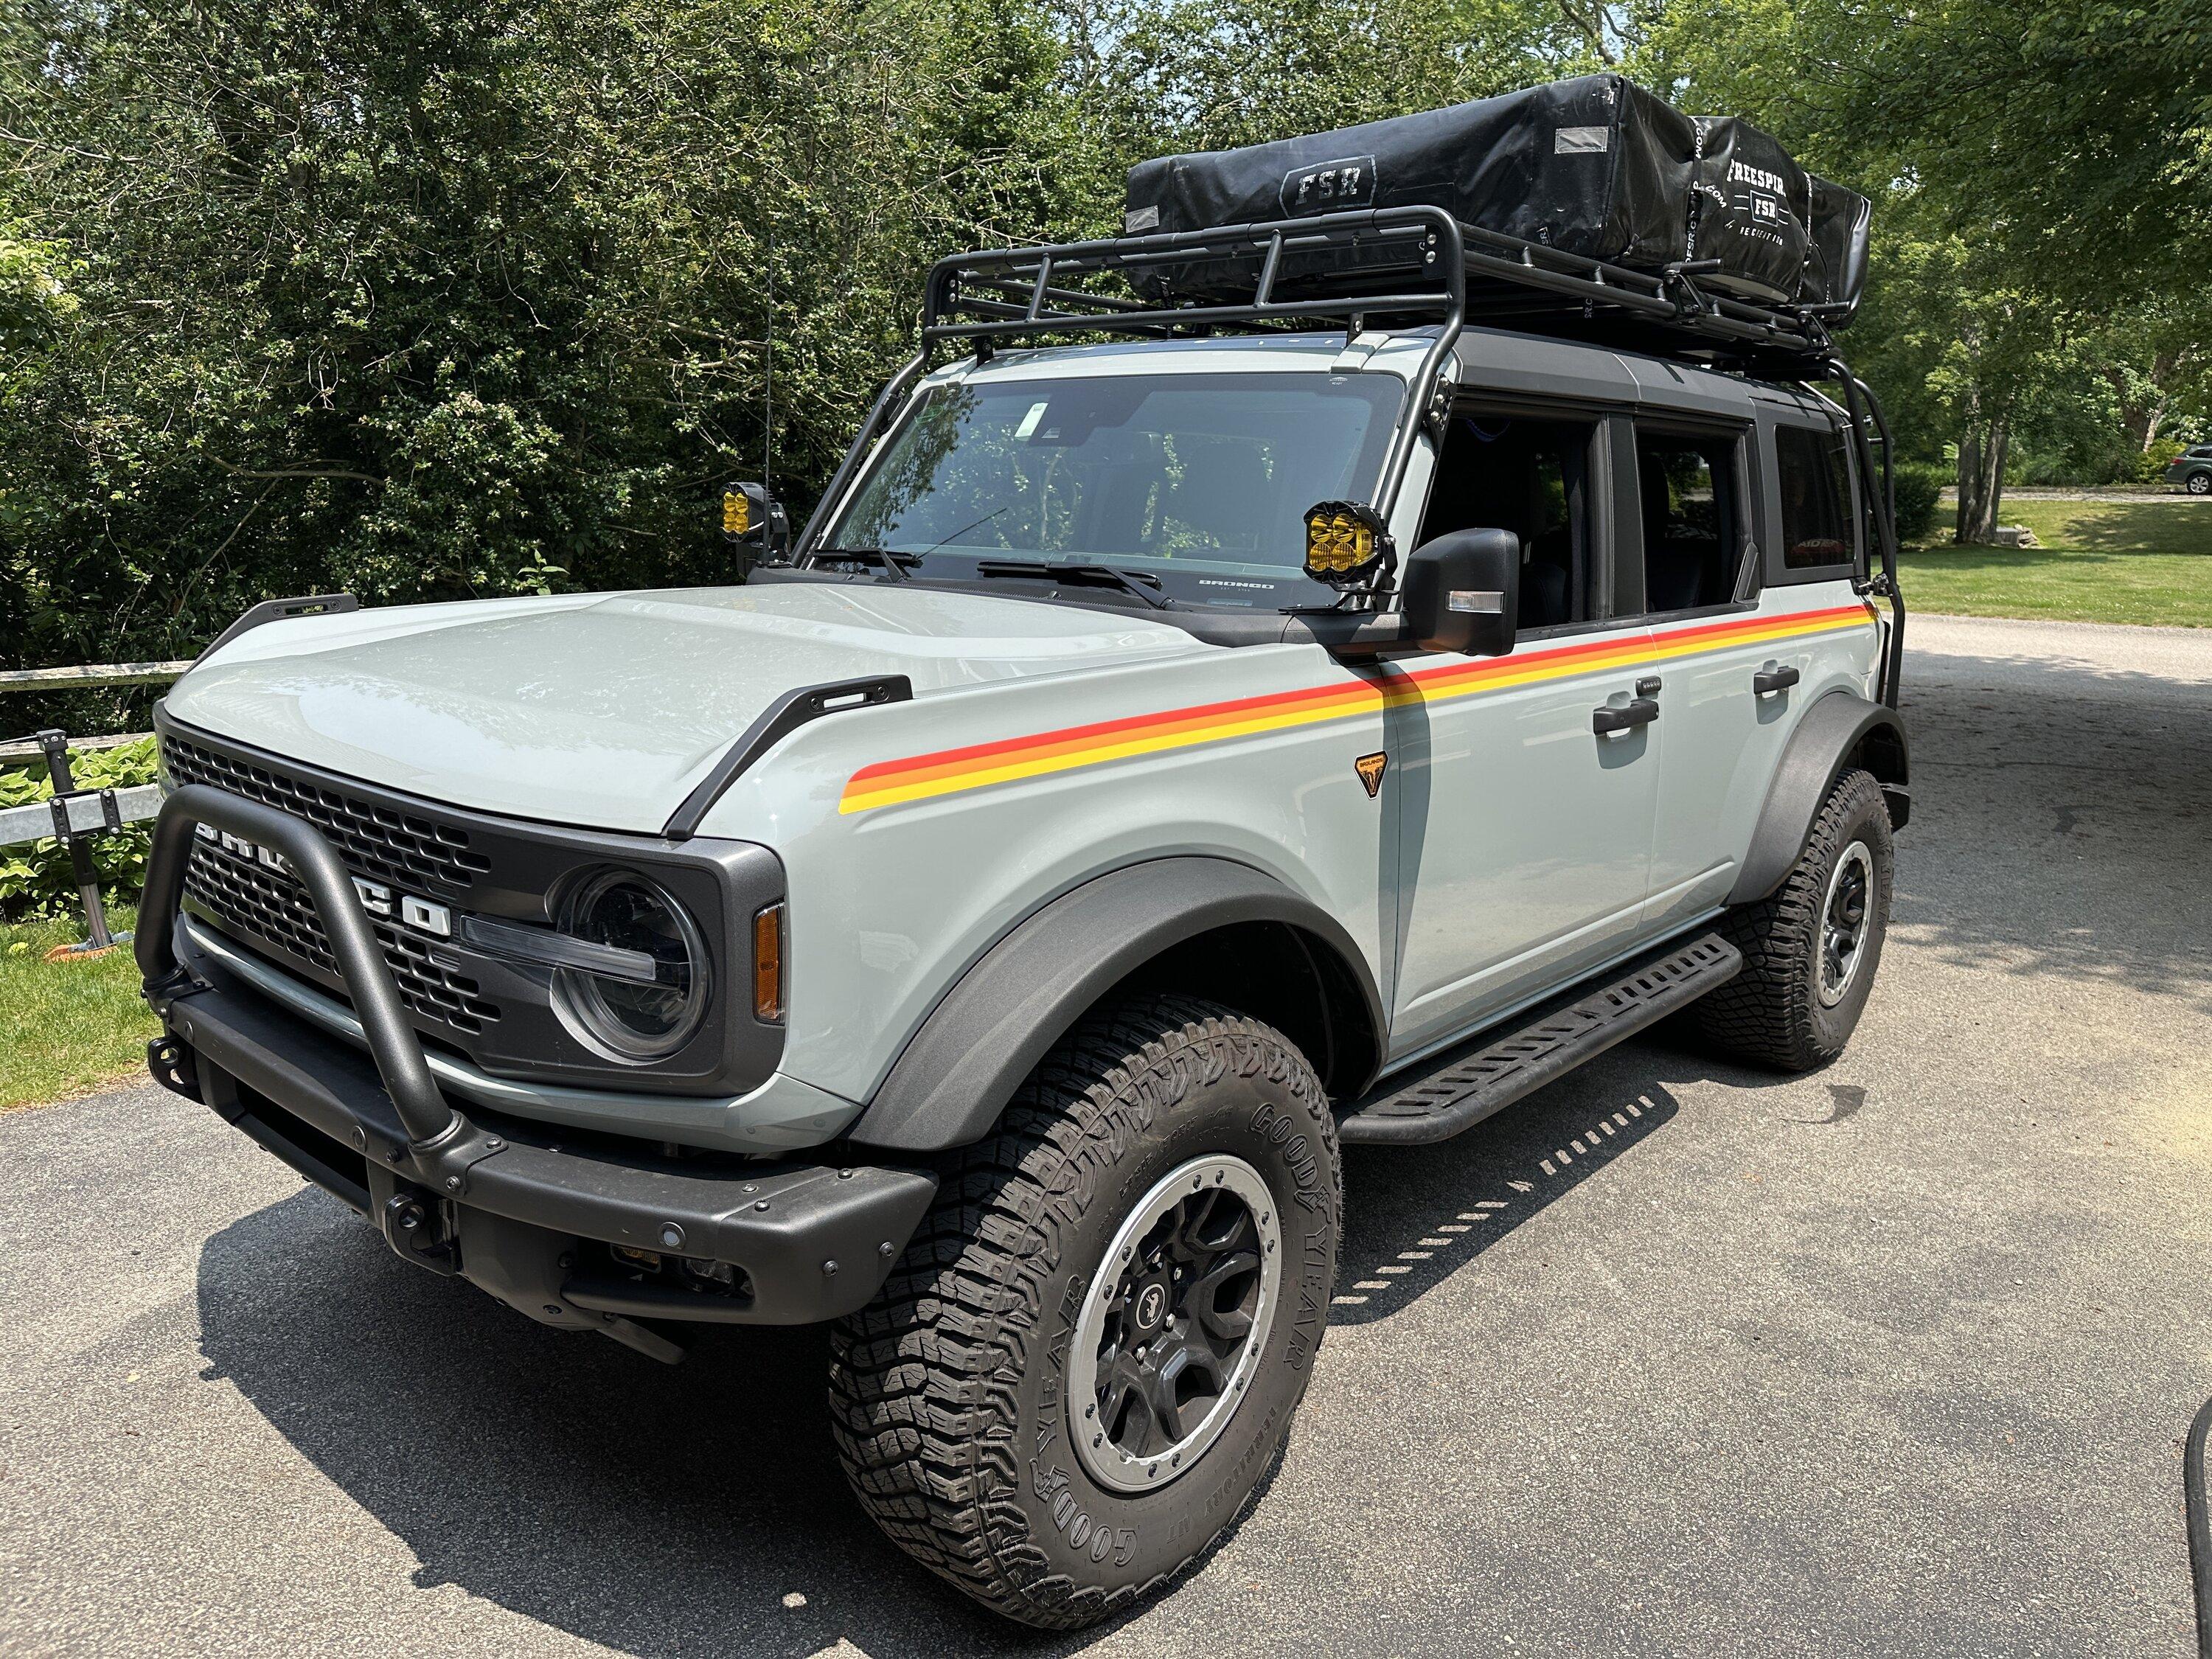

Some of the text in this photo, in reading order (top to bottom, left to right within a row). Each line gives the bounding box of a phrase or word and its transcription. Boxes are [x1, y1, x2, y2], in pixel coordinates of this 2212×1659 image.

[1295, 167, 1361, 206] FSR
[1755, 198, 1776, 218] FSR
[1198, 580, 1275, 589] BRONCO
